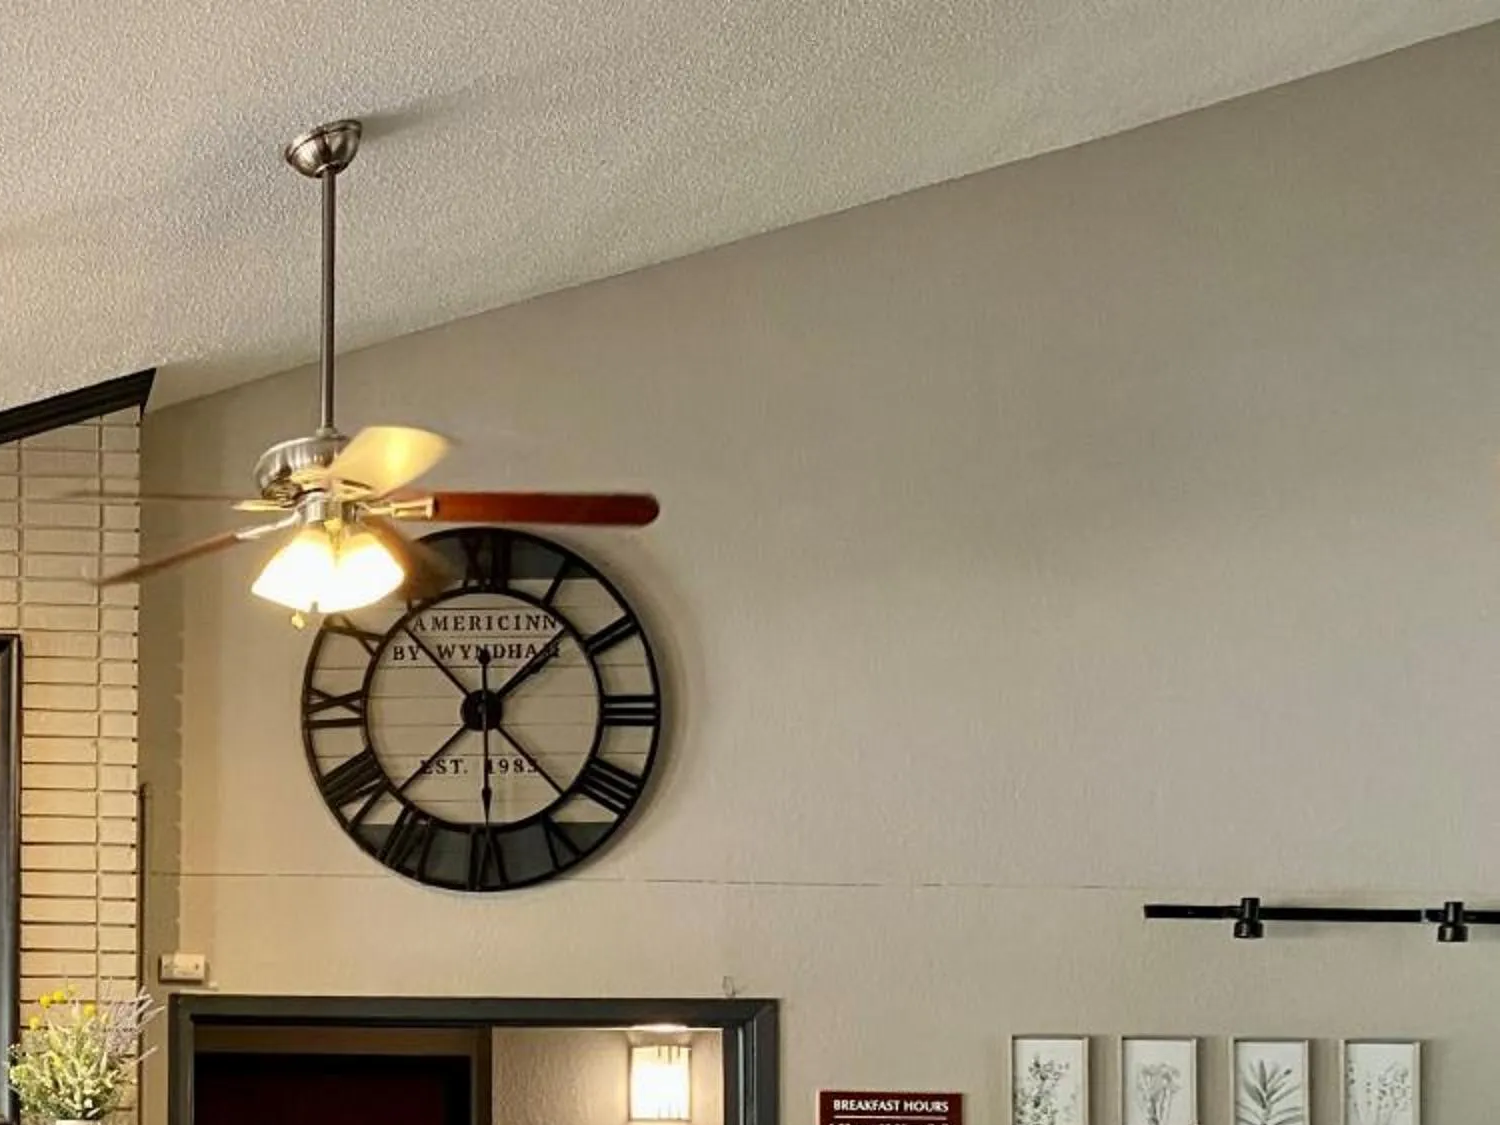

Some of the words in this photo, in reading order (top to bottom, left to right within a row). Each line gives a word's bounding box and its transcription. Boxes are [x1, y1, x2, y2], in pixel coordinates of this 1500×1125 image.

[413, 614, 557, 632] AMERICINN
[393, 645, 419, 661] BY
[421, 759, 468, 775] EST.
[833, 1099, 900, 1112] BREAKFAST
[903, 1101, 949, 1113] HOURS
